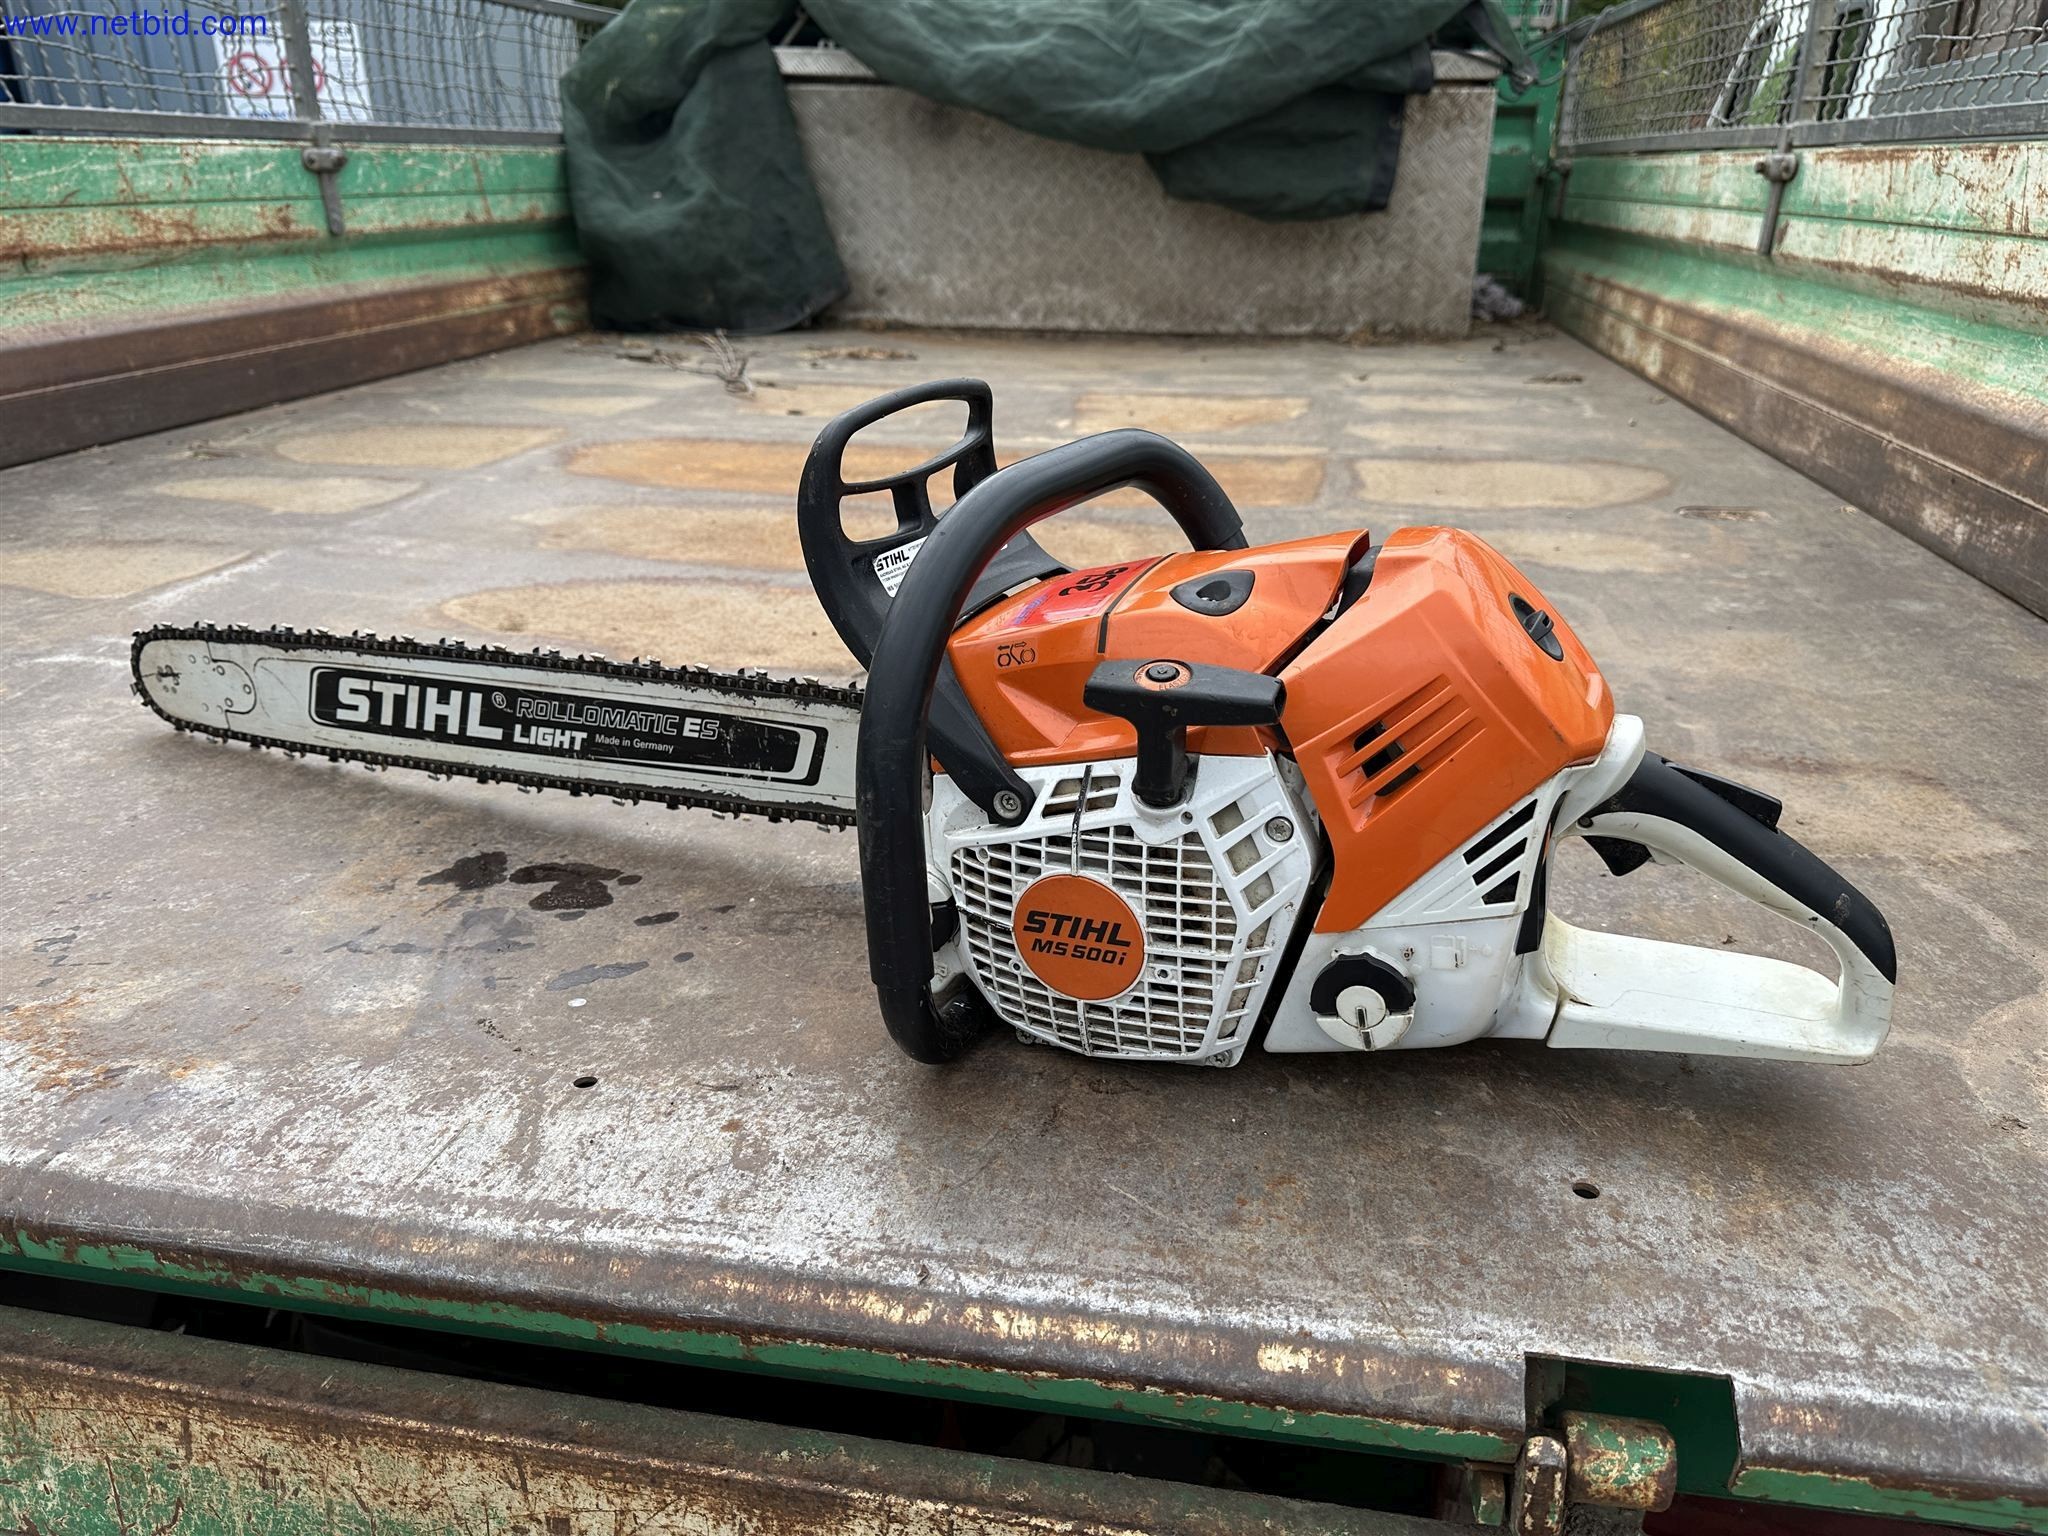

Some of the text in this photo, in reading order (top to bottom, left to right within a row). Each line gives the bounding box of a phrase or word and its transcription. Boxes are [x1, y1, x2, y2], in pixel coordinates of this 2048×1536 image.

[876, 549, 910, 572] STIHL
[336, 676, 720, 741] STIHL ROLLOMATIC ES
[513, 723, 674, 755] LIGHT Made in Germany
[1023, 910, 1131, 948] STIHL
[1031, 938, 1127, 966] MS 500i
